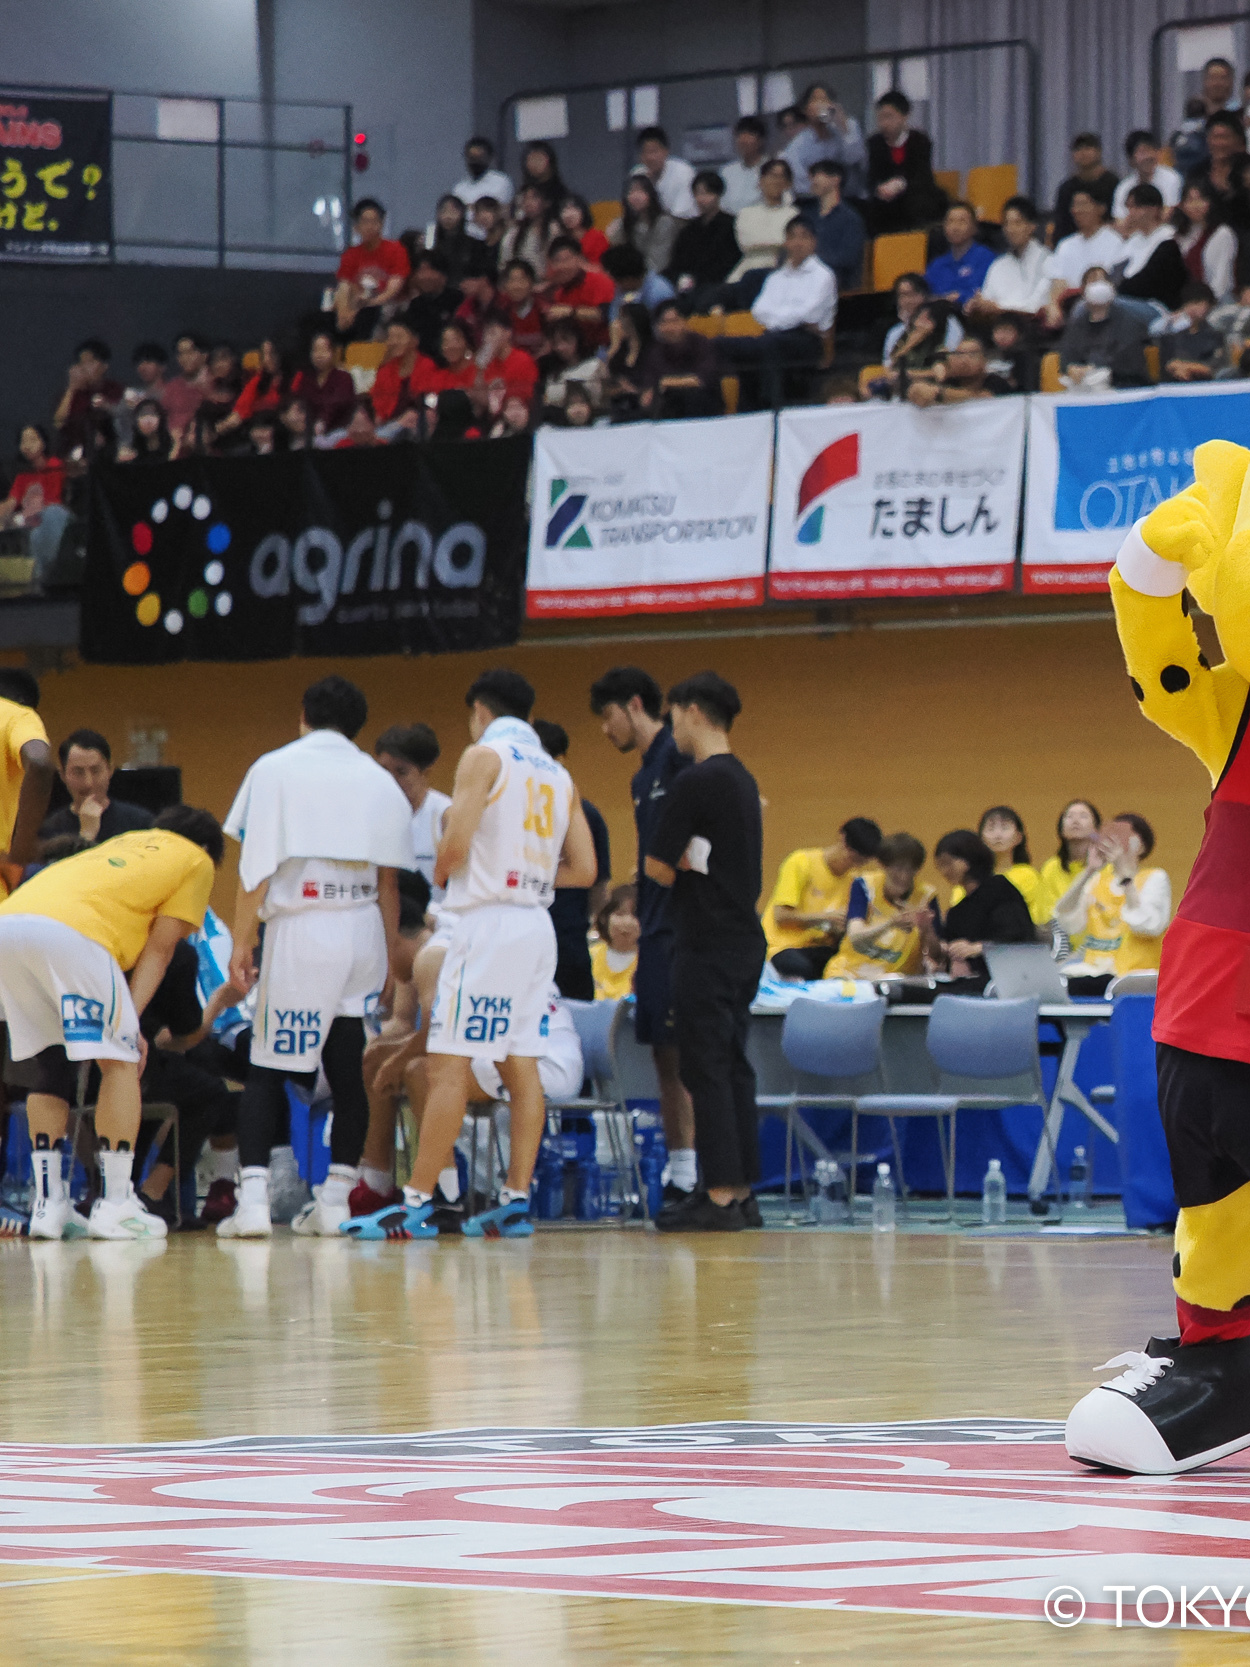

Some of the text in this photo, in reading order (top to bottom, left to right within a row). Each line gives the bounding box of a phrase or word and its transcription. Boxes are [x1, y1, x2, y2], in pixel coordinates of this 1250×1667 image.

[870, 495, 998, 539] たましん
[249, 498, 487, 627] agrina
[524, 776, 554, 839] 13
[274, 1009, 321, 1026] YKK
[470, 996, 511, 1014] YKK
[273, 1029, 320, 1055] ap
[464, 1015, 509, 1043] ap
[413, 1430, 1070, 1451] TOKY
